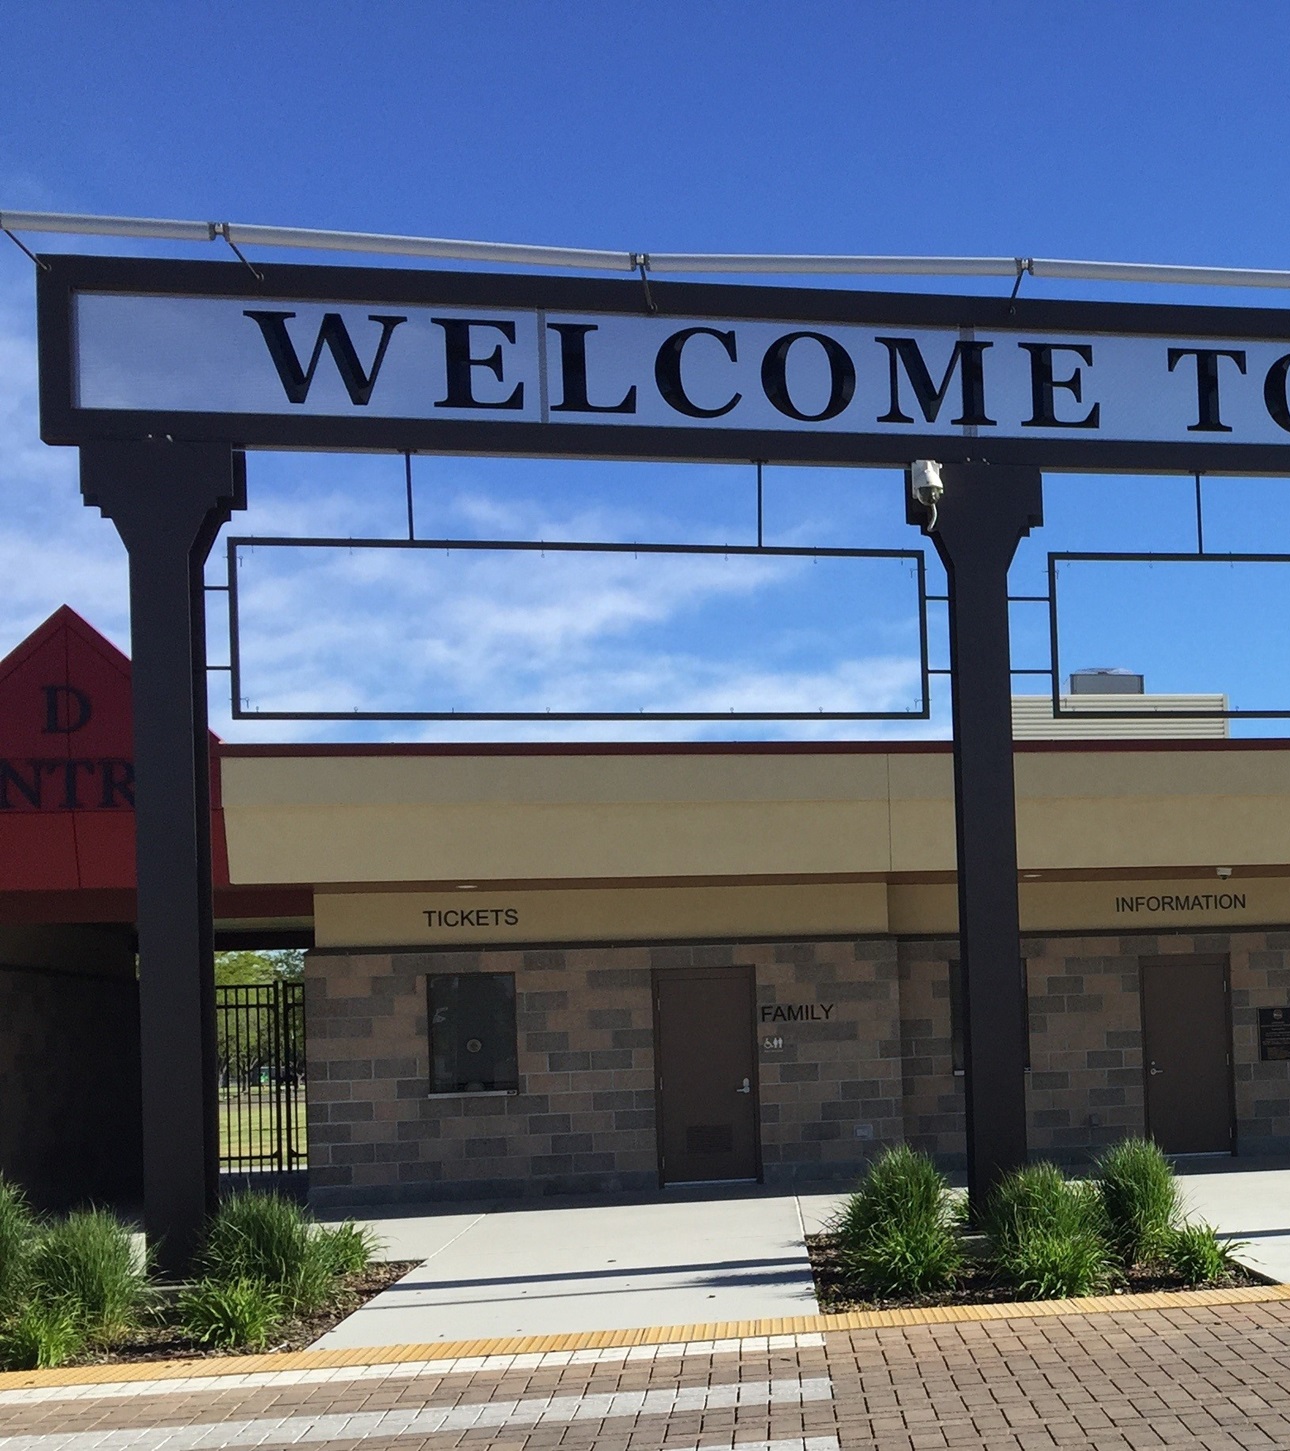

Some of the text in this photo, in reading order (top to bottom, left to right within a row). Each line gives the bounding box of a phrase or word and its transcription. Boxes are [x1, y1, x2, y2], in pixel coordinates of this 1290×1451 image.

[243, 309, 1100, 429] WELCOME
[41, 684, 92, 735] D
[0, 757, 136, 810] NTR
[422, 908, 519, 927] TICKETS
[1115, 893, 1246, 912] INFORMATION
[760, 1003, 834, 1022] FAMILY
